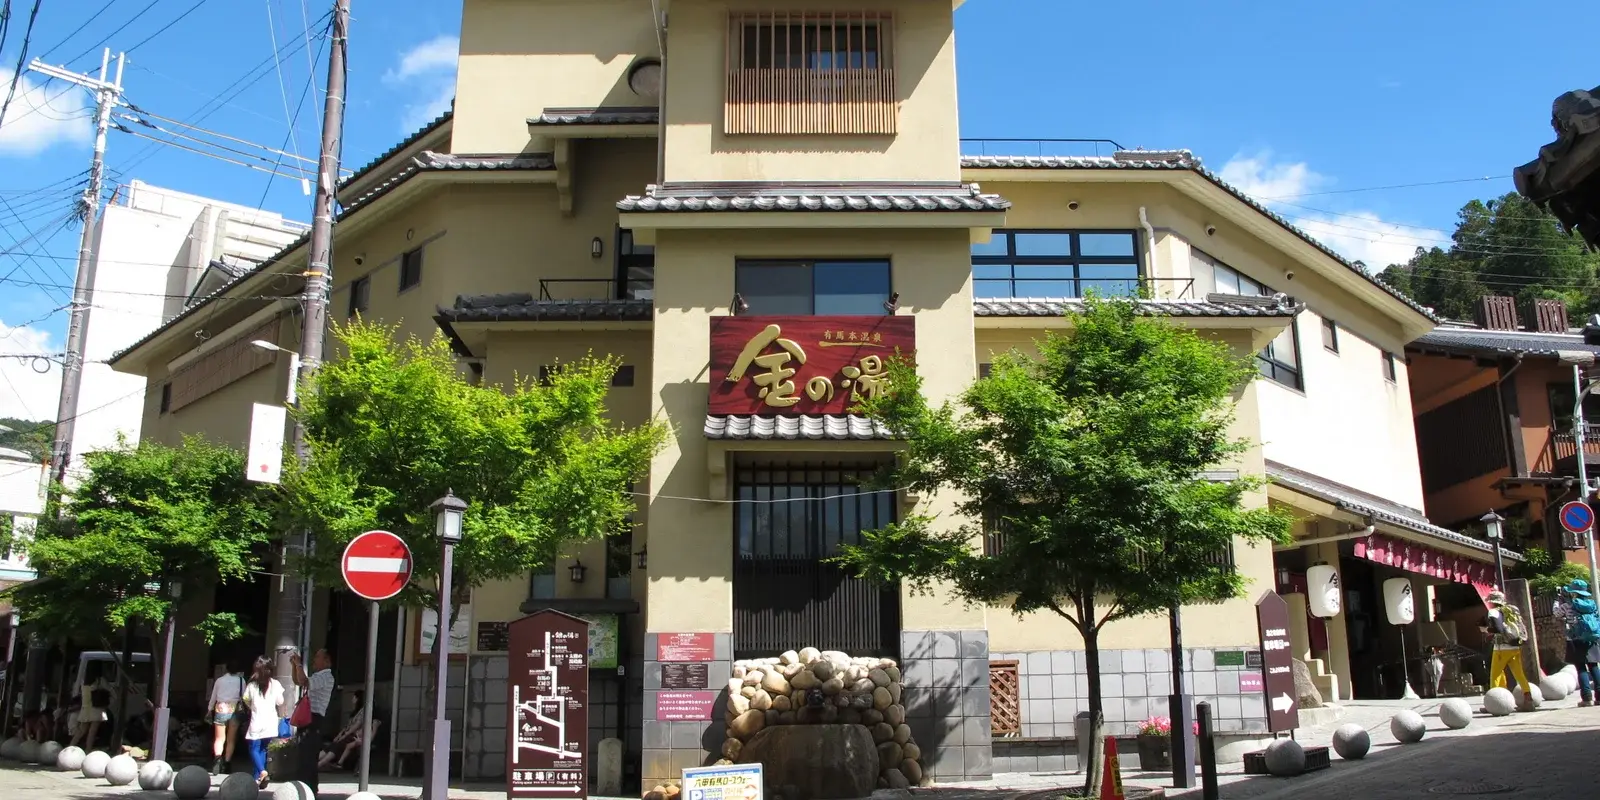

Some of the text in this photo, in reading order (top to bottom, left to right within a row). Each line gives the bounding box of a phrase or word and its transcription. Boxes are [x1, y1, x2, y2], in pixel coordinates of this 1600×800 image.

[824, 329, 884, 343] 有馬本温泉
[726, 323, 891, 407] 金の湯
